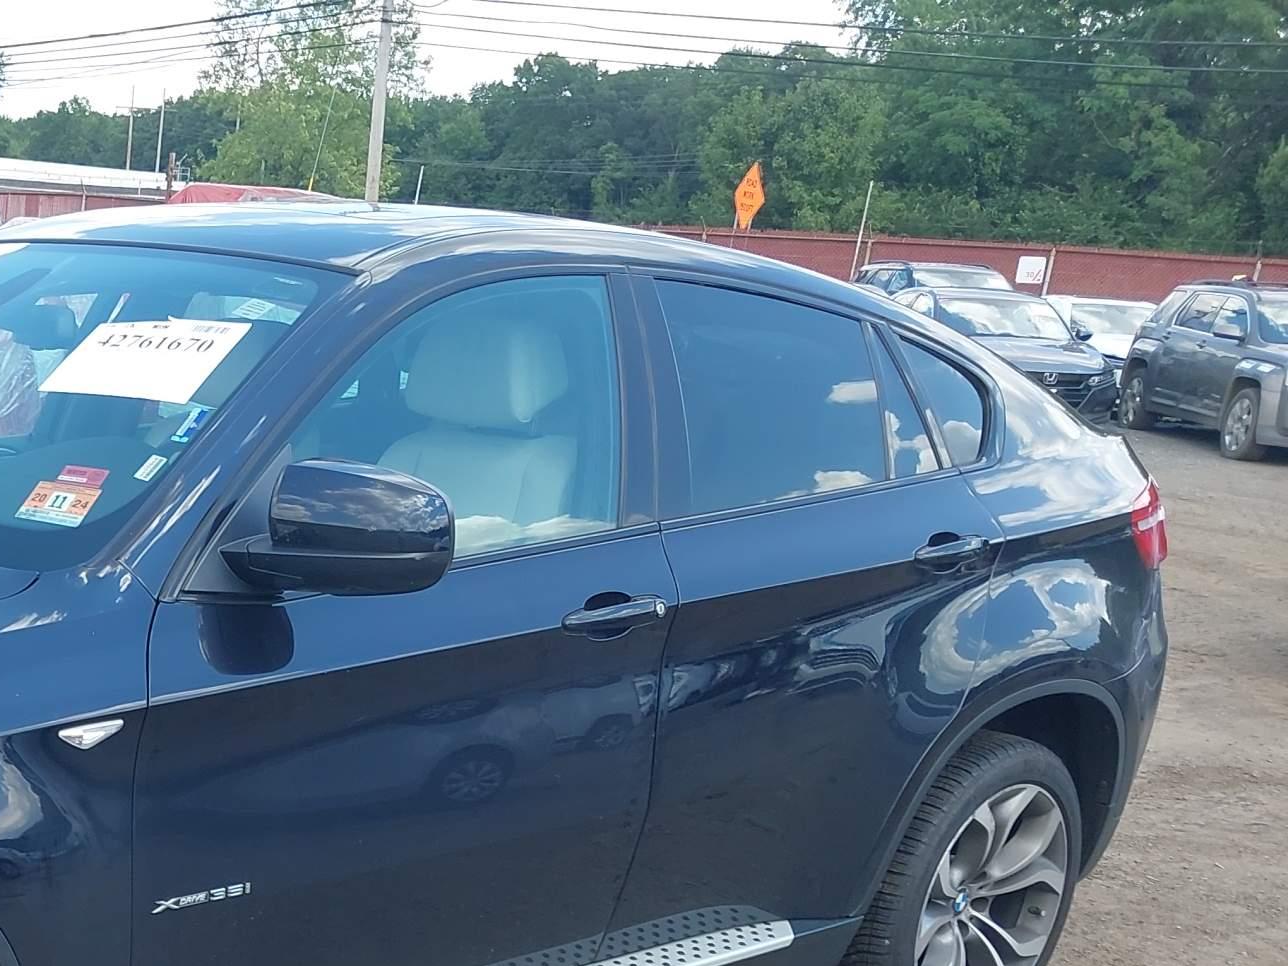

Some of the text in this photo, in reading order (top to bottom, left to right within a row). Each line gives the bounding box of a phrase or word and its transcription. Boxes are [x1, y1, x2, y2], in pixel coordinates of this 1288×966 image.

[96, 333, 216, 353] 42761670
[31, 492, 90, 510] 20 11 24
